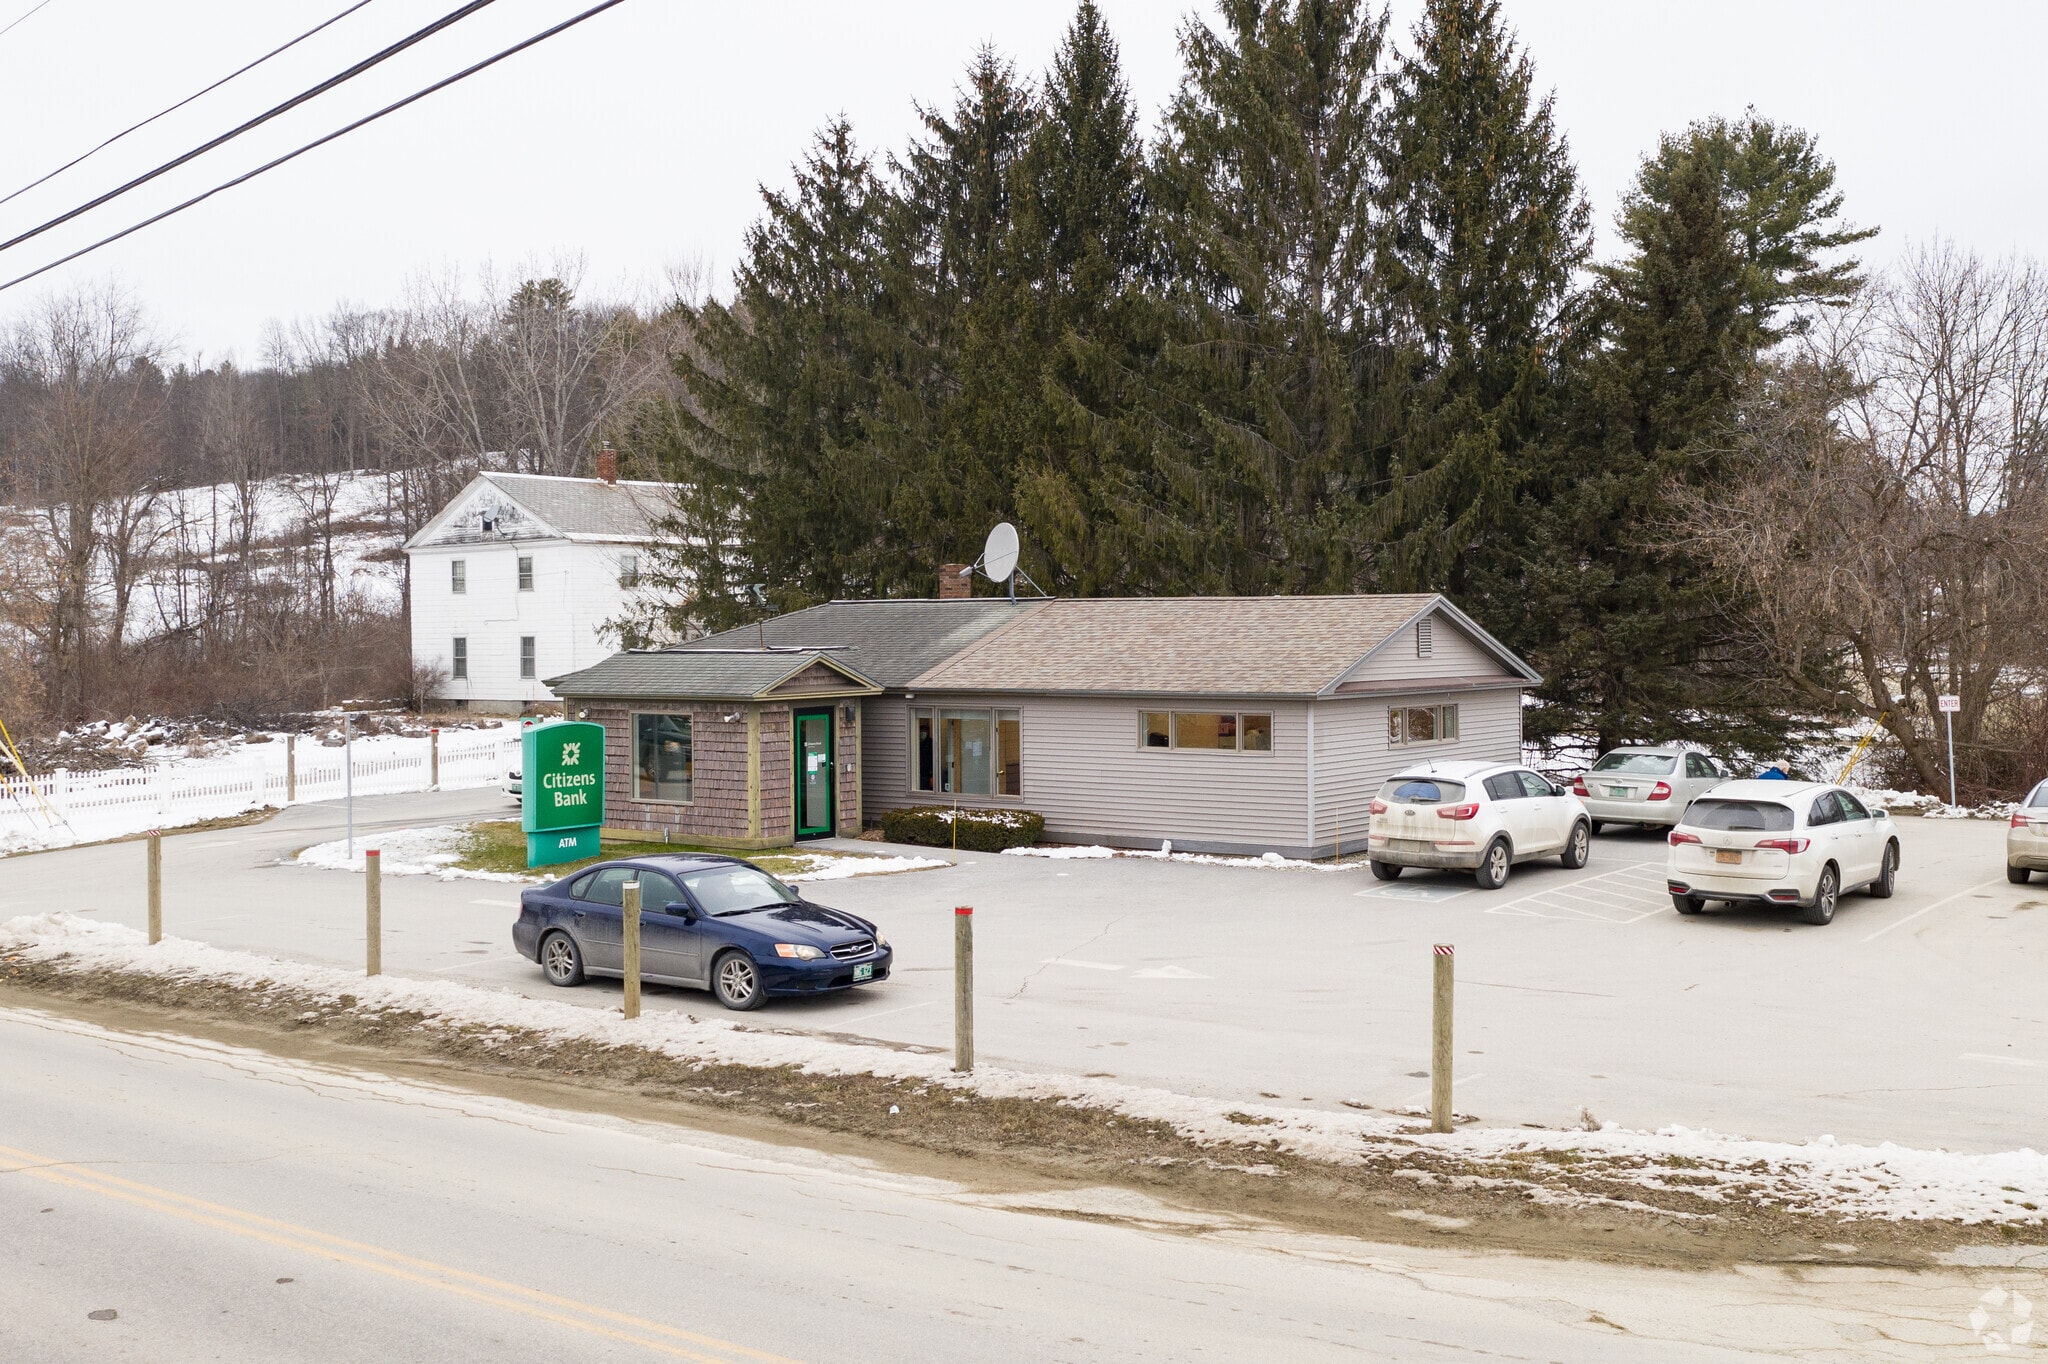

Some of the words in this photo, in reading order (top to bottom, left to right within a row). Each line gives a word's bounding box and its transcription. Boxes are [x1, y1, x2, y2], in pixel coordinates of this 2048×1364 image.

[1940, 699, 1958, 707] ENTER
[543, 772, 596, 789] Citizens
[554, 788, 587, 807] Bank
[558, 837, 577, 849] ATM
